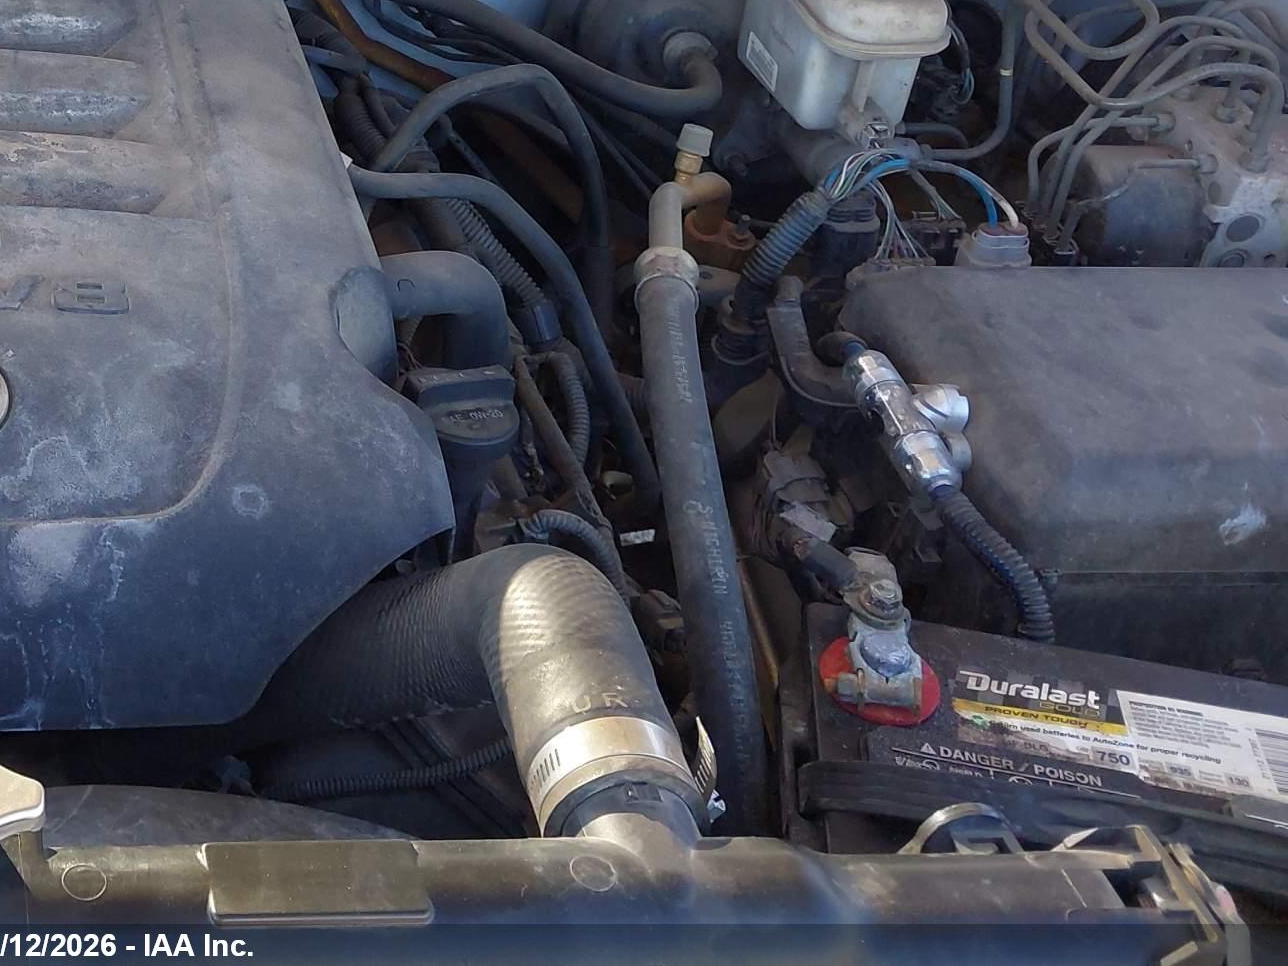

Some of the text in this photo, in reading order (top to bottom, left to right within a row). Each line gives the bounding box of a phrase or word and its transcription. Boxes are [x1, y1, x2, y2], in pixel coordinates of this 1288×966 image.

[959, 670, 1100, 710] Duralast
[984, 706, 1039, 720] PROVEN
[1039, 701, 1101, 717] GOLD
[1020, 724, 1041, 734] used
[1043, 727, 1081, 741] batteries
[1082, 734, 1092, 742] to
[1093, 736, 1135, 749] AutoZone
[1136, 743, 1149, 752] for
[1150, 746, 1180, 757] proper
[1181, 751, 1223, 765] recycling
[1096, 750, 1132, 767] 750
[939, 745, 1014, 771] DANGER
[1033, 763, 1103, 787] POISON
